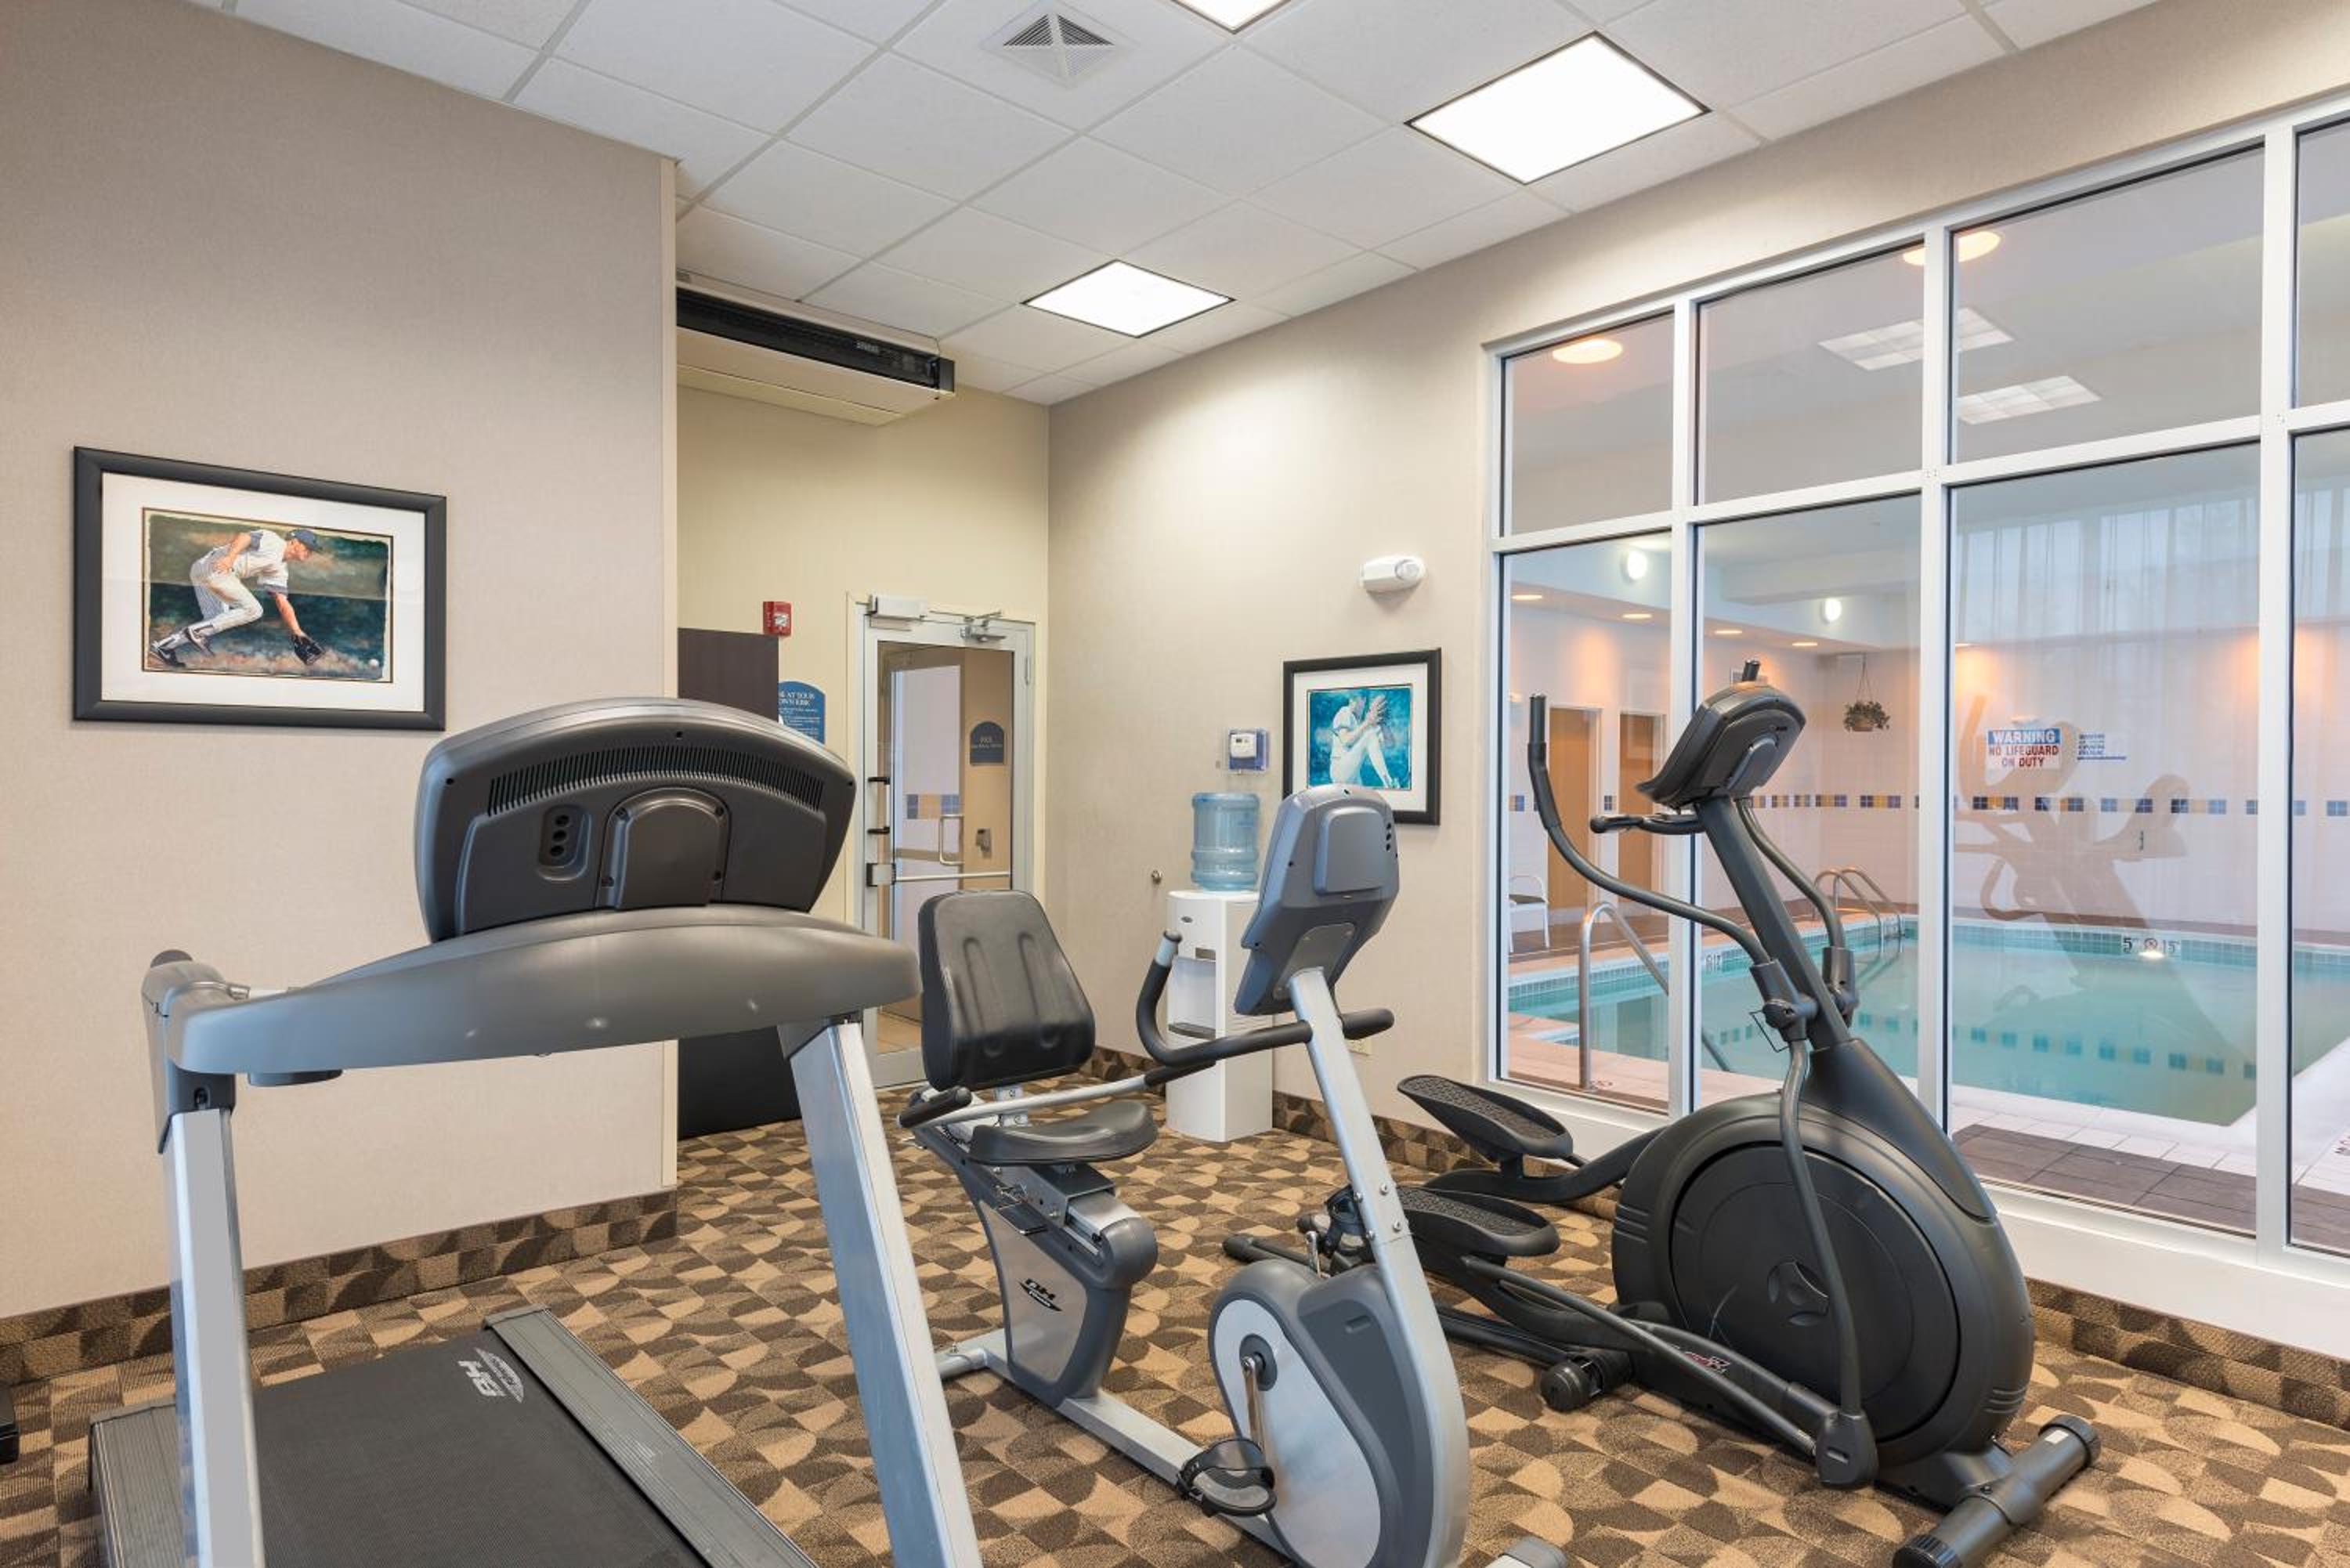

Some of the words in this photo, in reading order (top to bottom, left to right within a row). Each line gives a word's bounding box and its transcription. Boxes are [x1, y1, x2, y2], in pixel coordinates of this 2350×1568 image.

[1993, 730, 2055, 744] WARNING
[1989, 746, 2001, 756] NO
[2006, 745, 2059, 756] LIFEGUARD
[2001, 757, 2016, 767] ON
[2019, 757, 2045, 768] DUTY
